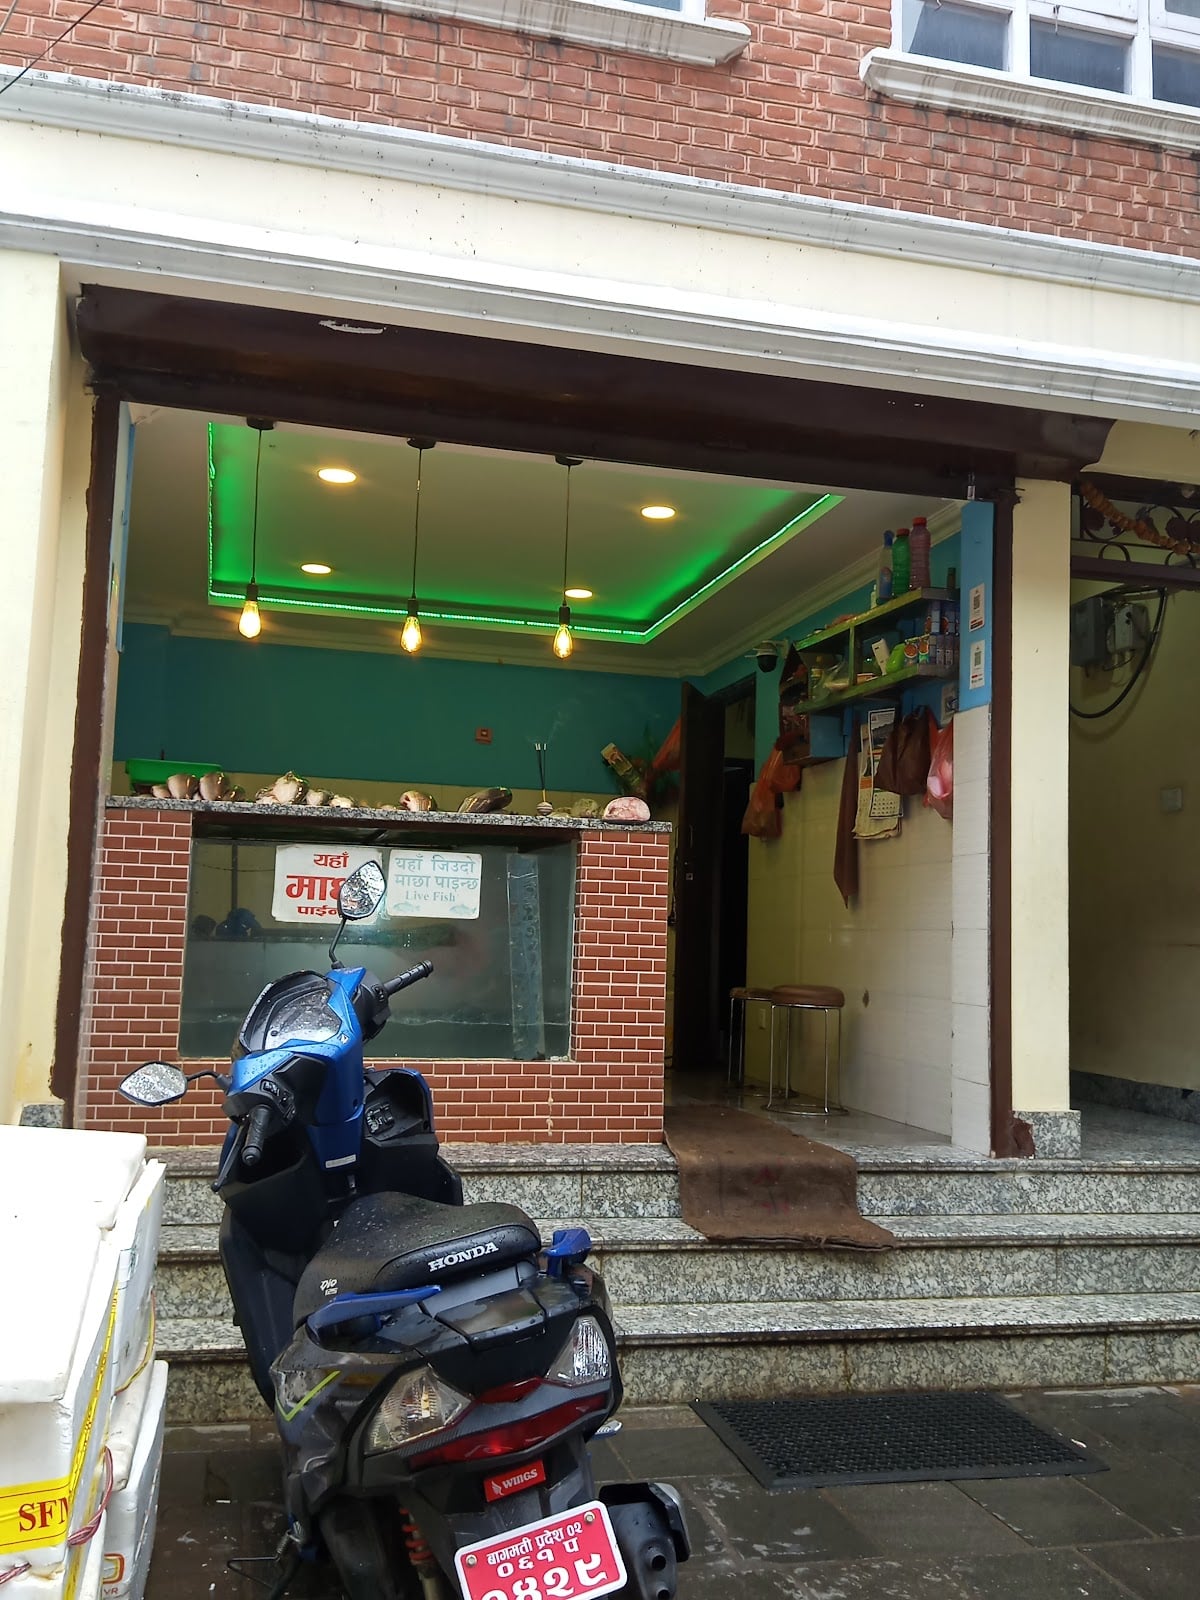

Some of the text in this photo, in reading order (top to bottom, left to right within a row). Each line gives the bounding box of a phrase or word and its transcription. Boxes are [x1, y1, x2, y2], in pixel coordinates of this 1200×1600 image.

[313, 851, 350, 869] यहाँ
[394, 853, 424, 873] यहाँ
[394, 874, 479, 893] माछा पाइन्छ
[405, 890, 456, 903] Live Fish
[427, 1241, 499, 1273] HONDA
[486, 1521, 584, 1566] बागमती प्रदेश ०२
[496, 1537, 581, 1578] ०६१ प
